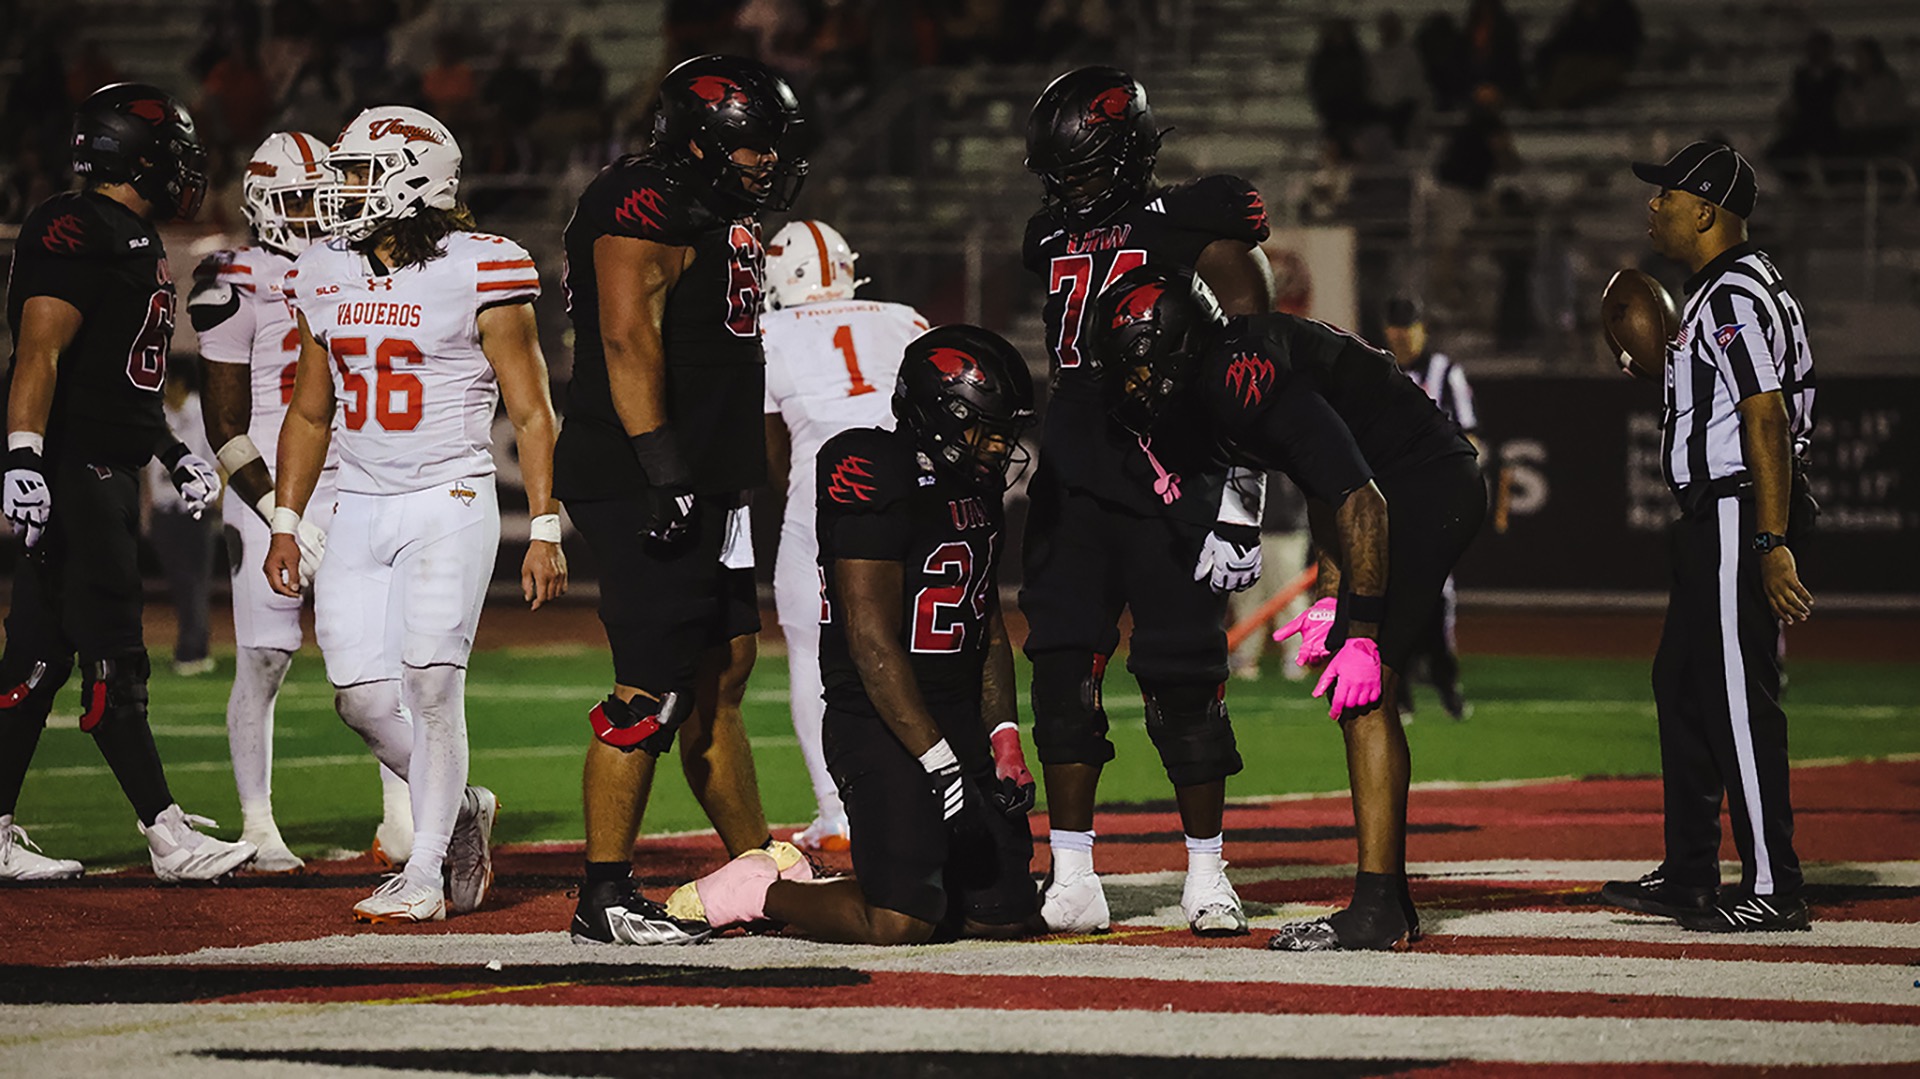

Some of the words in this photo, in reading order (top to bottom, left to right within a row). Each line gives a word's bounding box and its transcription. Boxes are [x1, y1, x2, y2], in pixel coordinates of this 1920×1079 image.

[1700, 181, 1711, 192] S
[337, 302, 423, 327] VAQUEROS
[330, 337, 424, 430] 56
[833, 324, 877, 397] 1
